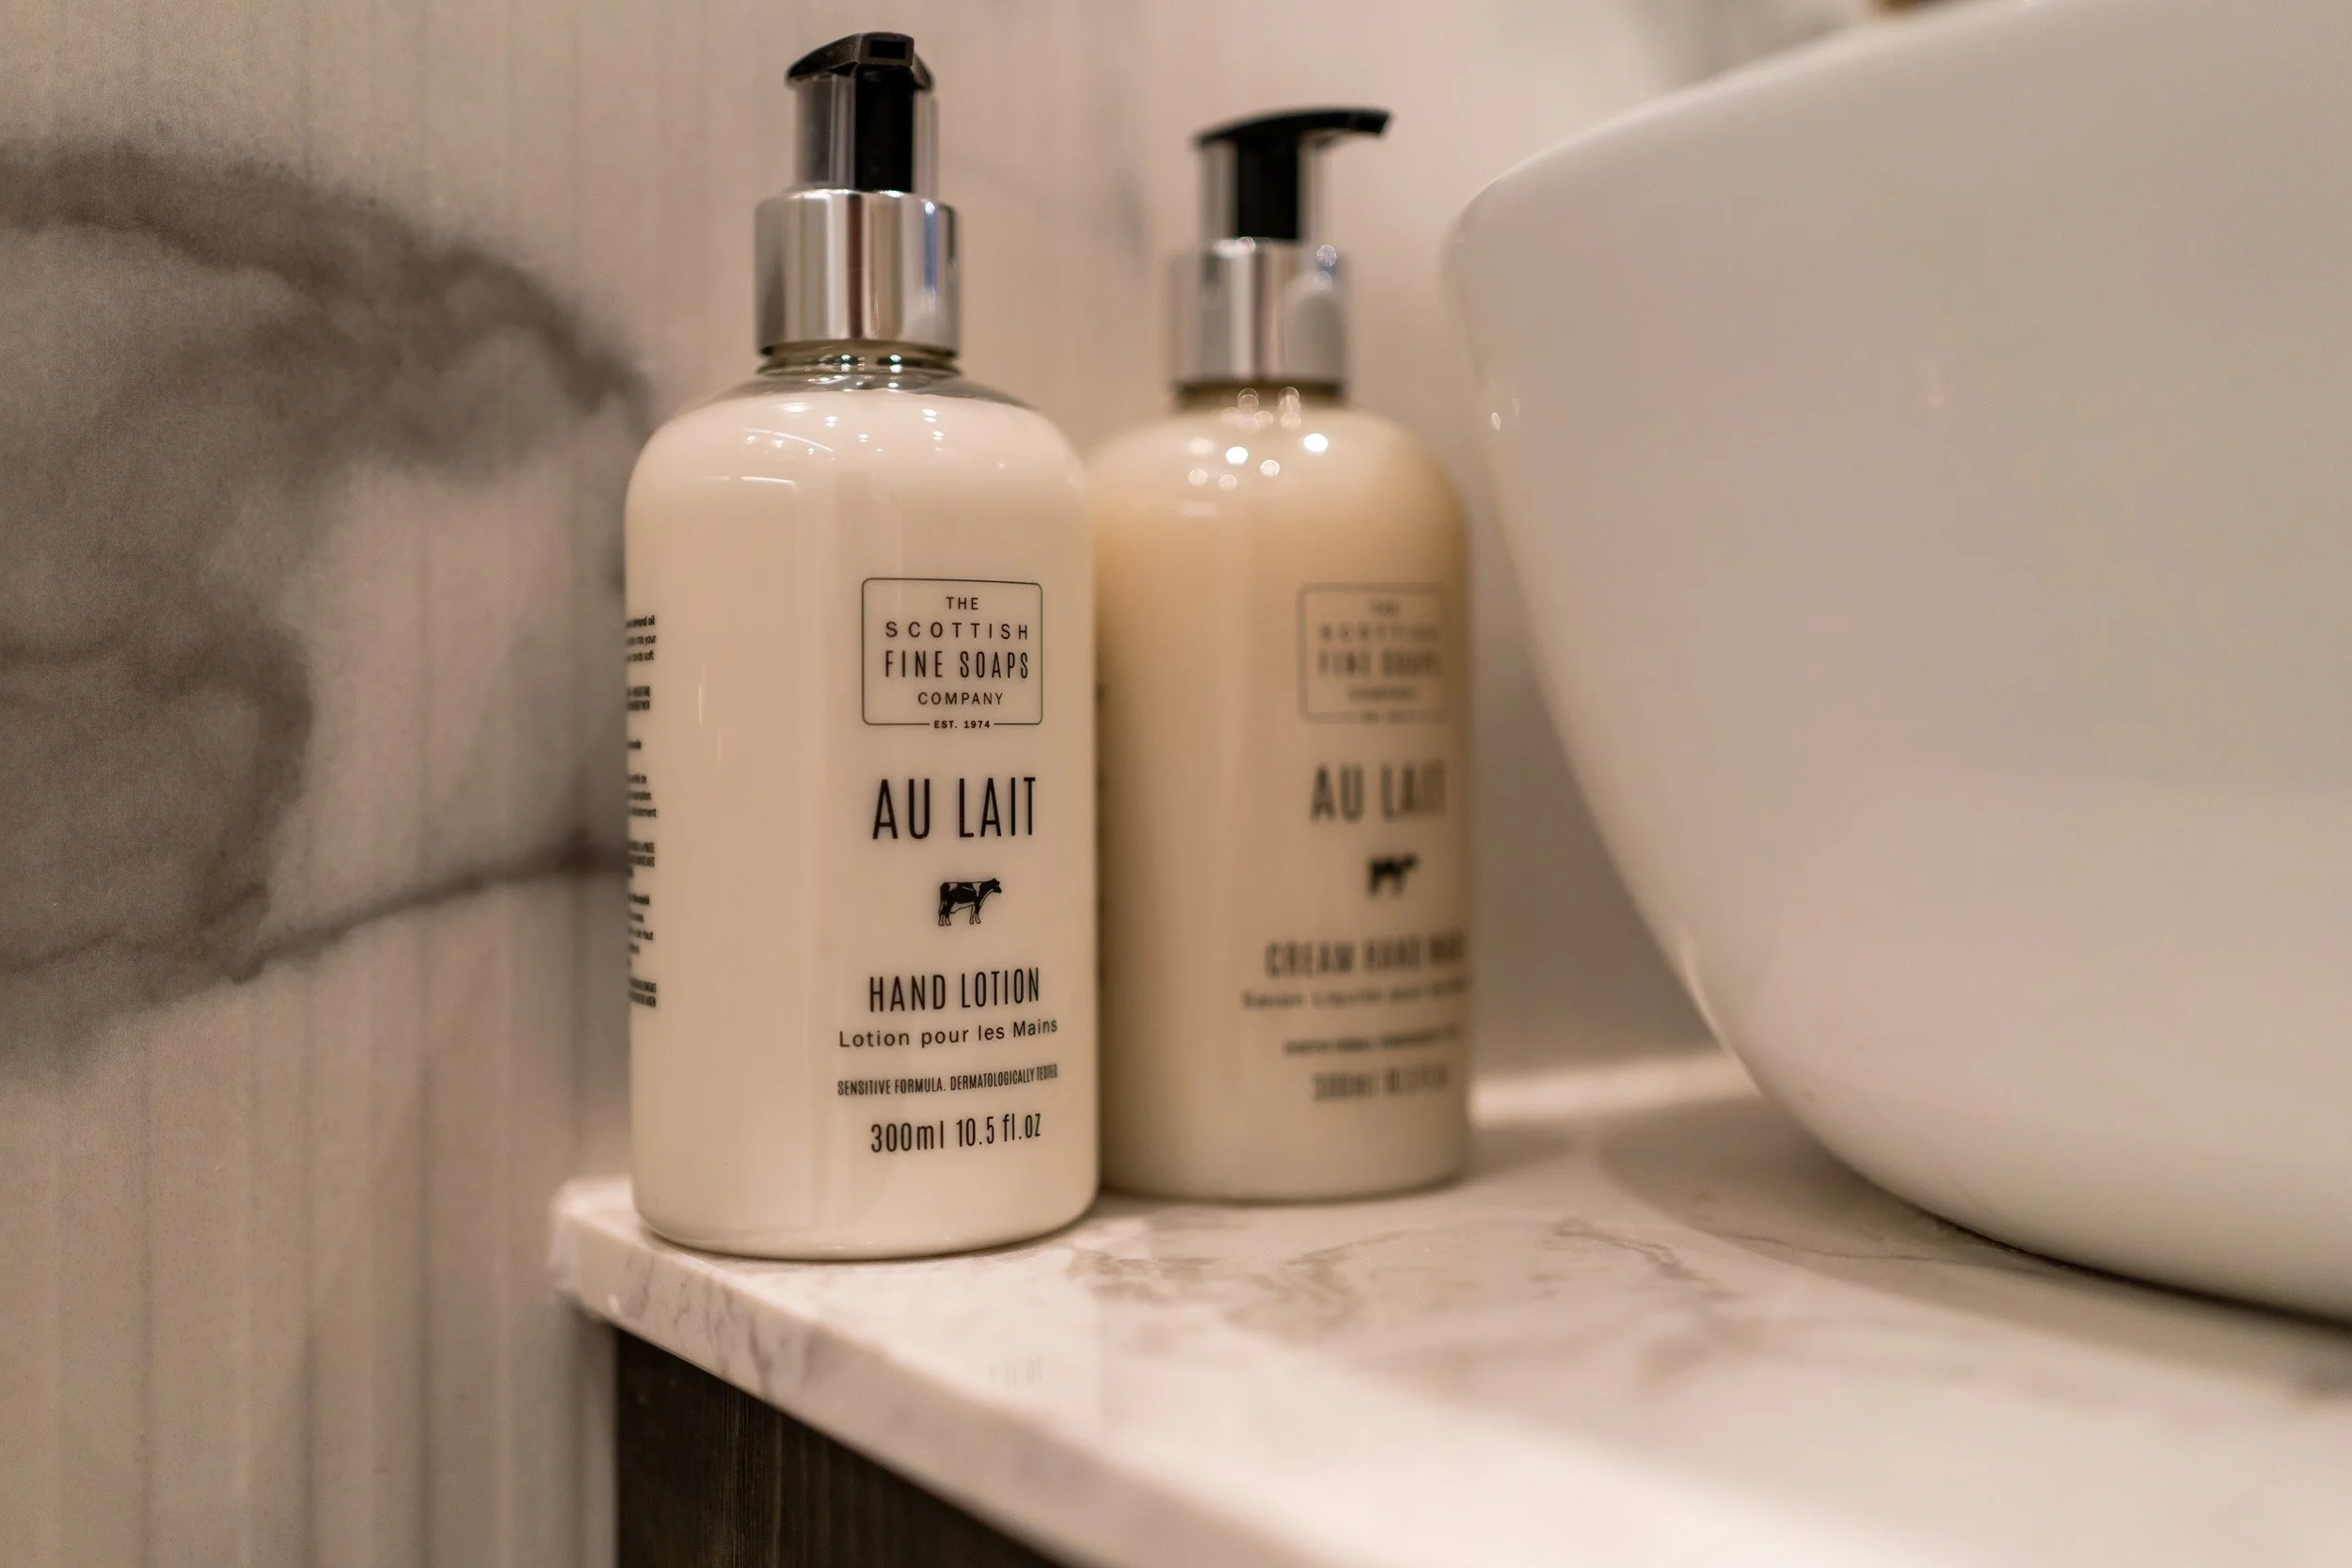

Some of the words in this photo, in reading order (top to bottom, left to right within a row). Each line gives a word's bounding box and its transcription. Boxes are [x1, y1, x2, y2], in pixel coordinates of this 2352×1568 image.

[946, 596, 979, 610] THE
[885, 621, 1028, 641] SCOTTISH
[884, 650, 944, 678] FINE
[960, 650, 1029, 679] SOAPS
[917, 691, 1004, 705] COMPANY
[933, 720, 958, 730] EST.
[963, 720, 991, 730] 1974
[1310, 761, 1364, 823] AU
[871, 778, 930, 840] AU
[959, 776, 1037, 838] LAIT
[868, 974, 946, 1013] HAND
[961, 967, 1040, 1008] LOTION
[839, 1030, 910, 1048] Lotion
[921, 1028, 969, 1049] pour
[978, 1024, 1005, 1041] les
[1013, 1019, 1058, 1037] Mains
[837, 1079, 891, 1096] SENSITIVE
[895, 1077, 946, 1094] FORMULA.
[950, 1067, 1035, 1091] DERMATOLOGICALLY
[871, 1120, 944, 1153] 300ml
[956, 1117, 994, 1148] 10.5
